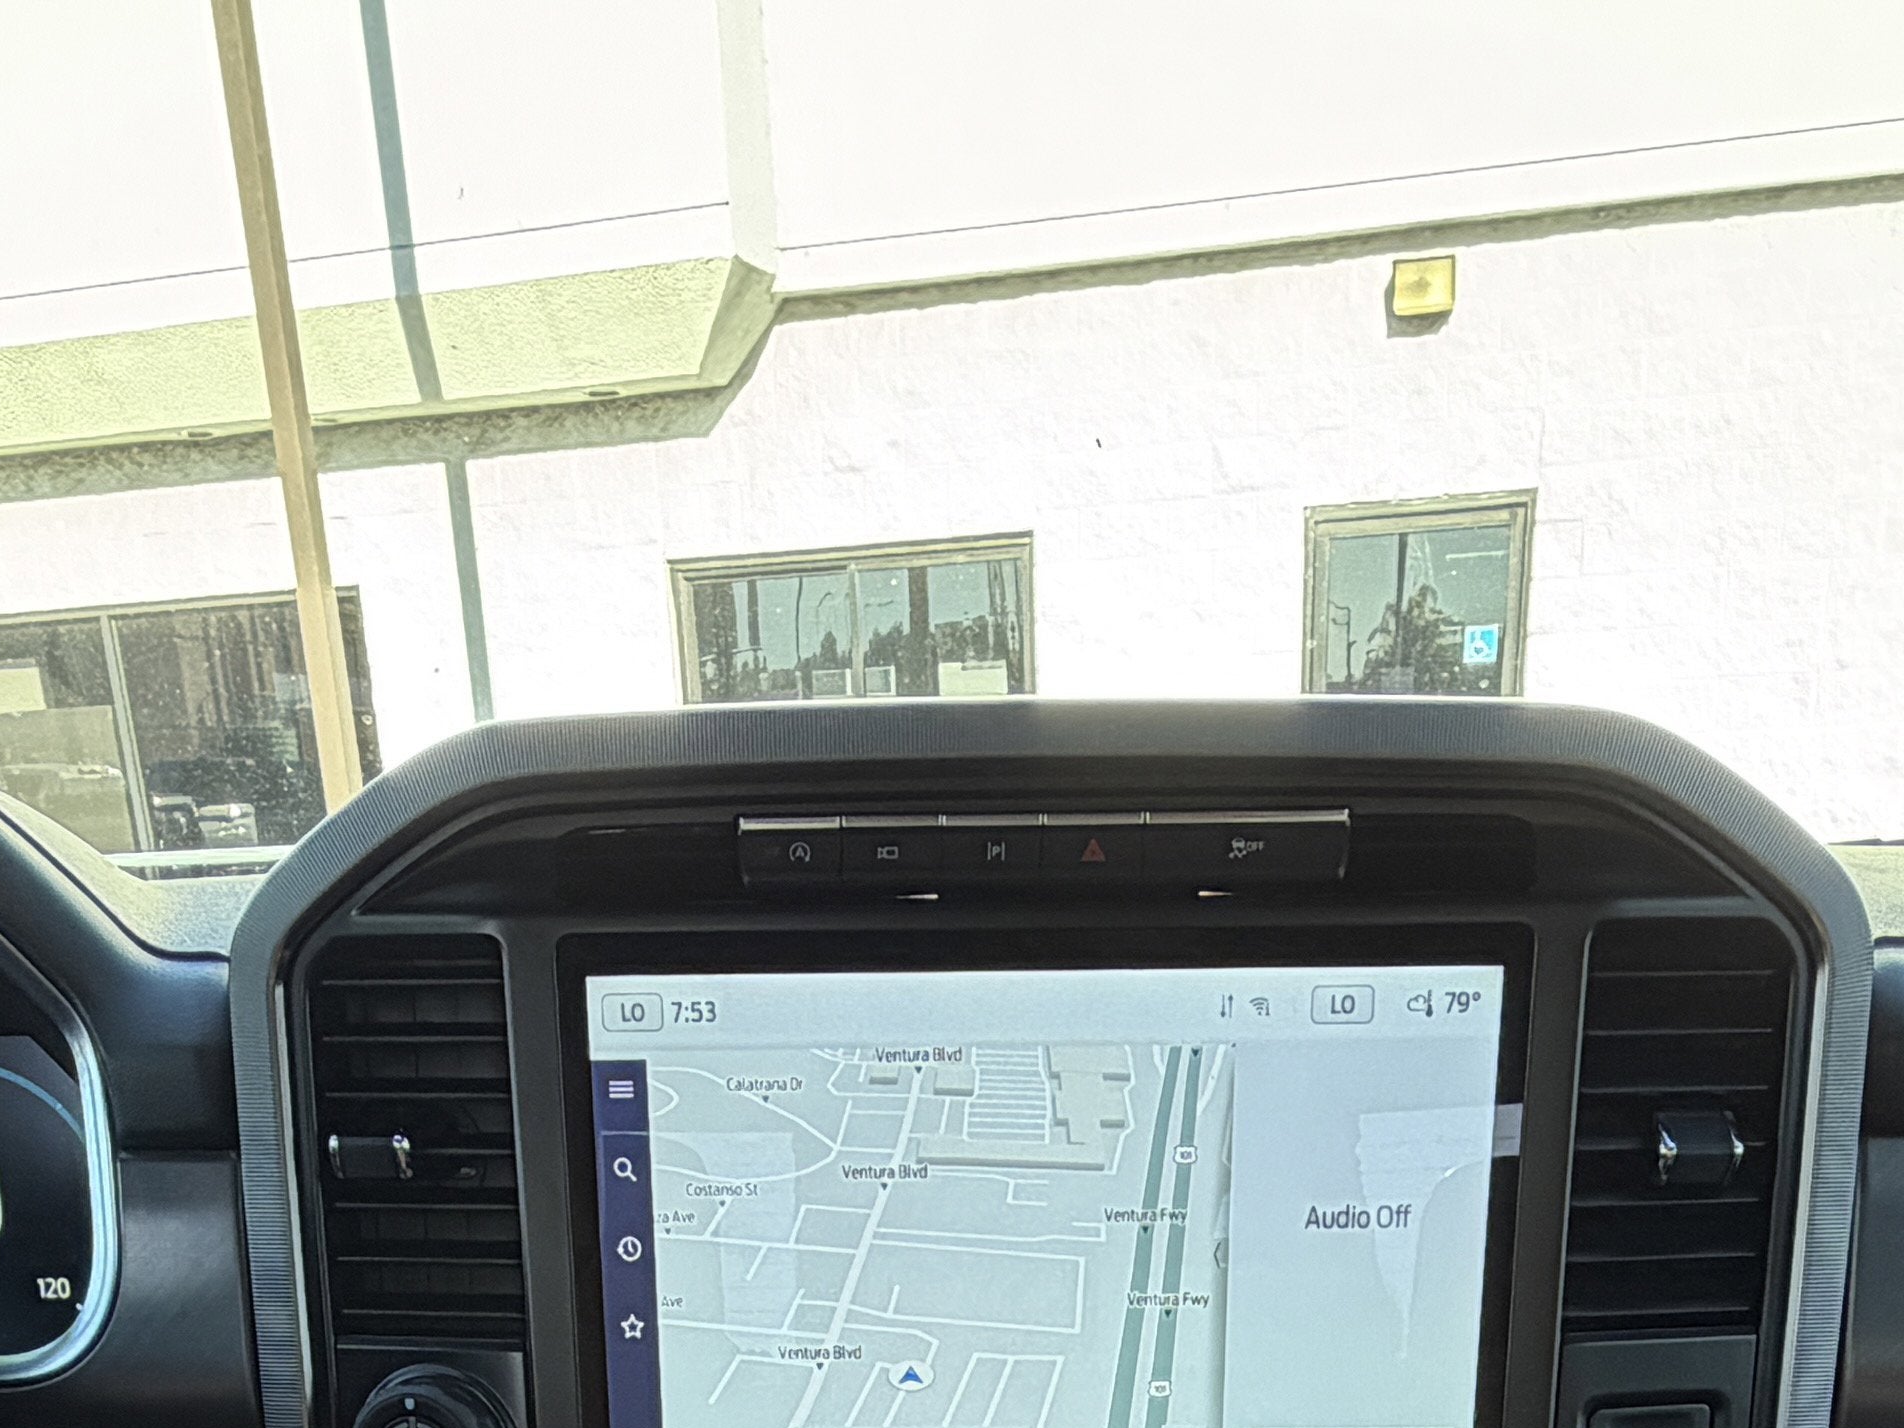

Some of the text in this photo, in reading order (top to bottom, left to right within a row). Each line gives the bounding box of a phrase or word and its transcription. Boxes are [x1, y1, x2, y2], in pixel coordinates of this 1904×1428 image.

[1330, 994, 1356, 1015] LO
[1444, 991, 1482, 1014] 79°
[620, 1002, 645, 1023] LO
[670, 1001, 718, 1023] 7:53
[875, 1047, 963, 1063] Ventura Blvd
[788, 1076, 803, 1091] Dr
[842, 1164, 928, 1180] Ventura Blvd
[686, 1182, 758, 1197] Costanso St
[672, 1210, 695, 1225] Ave
[1104, 1208, 1187, 1225] Ventura Fwy
[1305, 1203, 1413, 1231] Audio Off
[37, 1276, 71, 1301] 120
[661, 1296, 684, 1309] Ave
[1127, 1292, 1210, 1310] Ventura Fwy
[777, 1344, 863, 1361] Ventura Blvd
